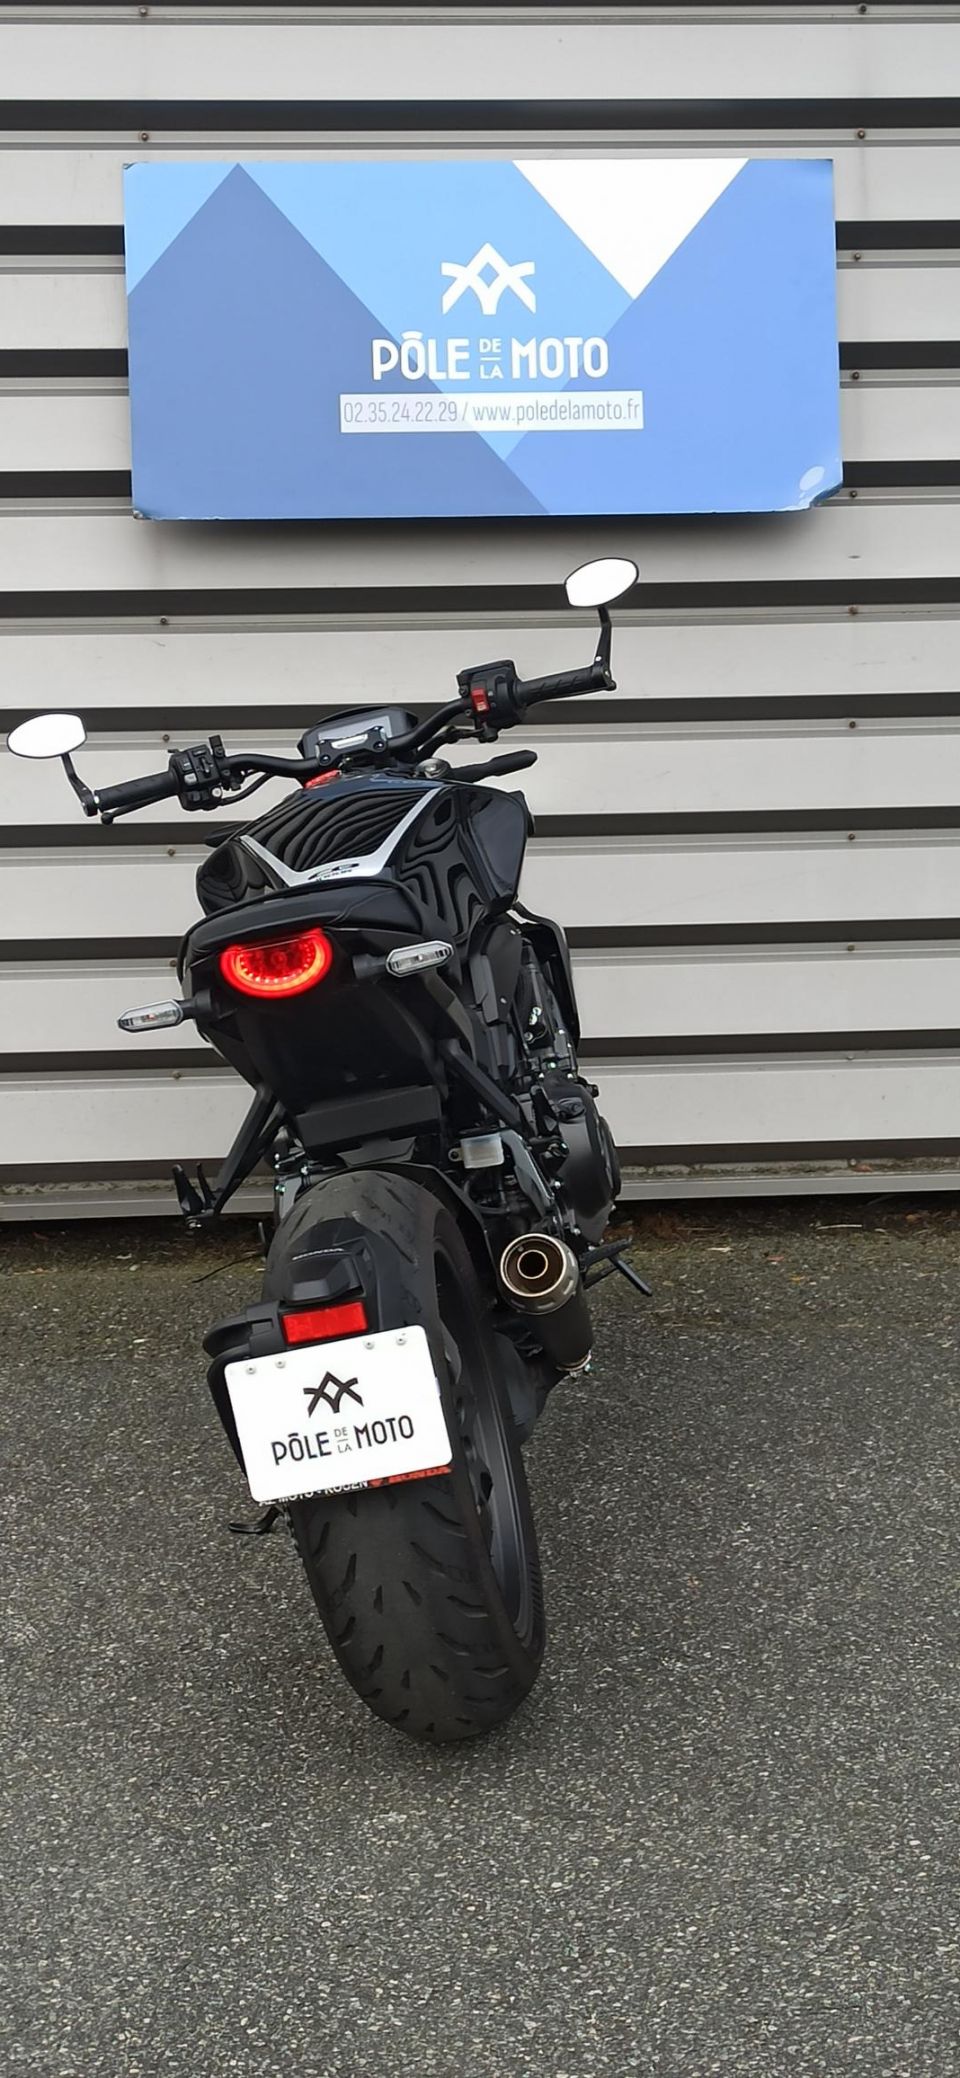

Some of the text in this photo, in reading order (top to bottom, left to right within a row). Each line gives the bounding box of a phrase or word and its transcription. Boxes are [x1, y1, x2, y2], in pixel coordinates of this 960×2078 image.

[372, 330, 609, 381] PÔLE DE LA MOTO
[343, 401, 459, 424] 02.35.24.22.29
[472, 398, 641, 425] www.poledelamoto.fr
[271, 1415, 415, 1466] PÔLE DE LA MOTO
